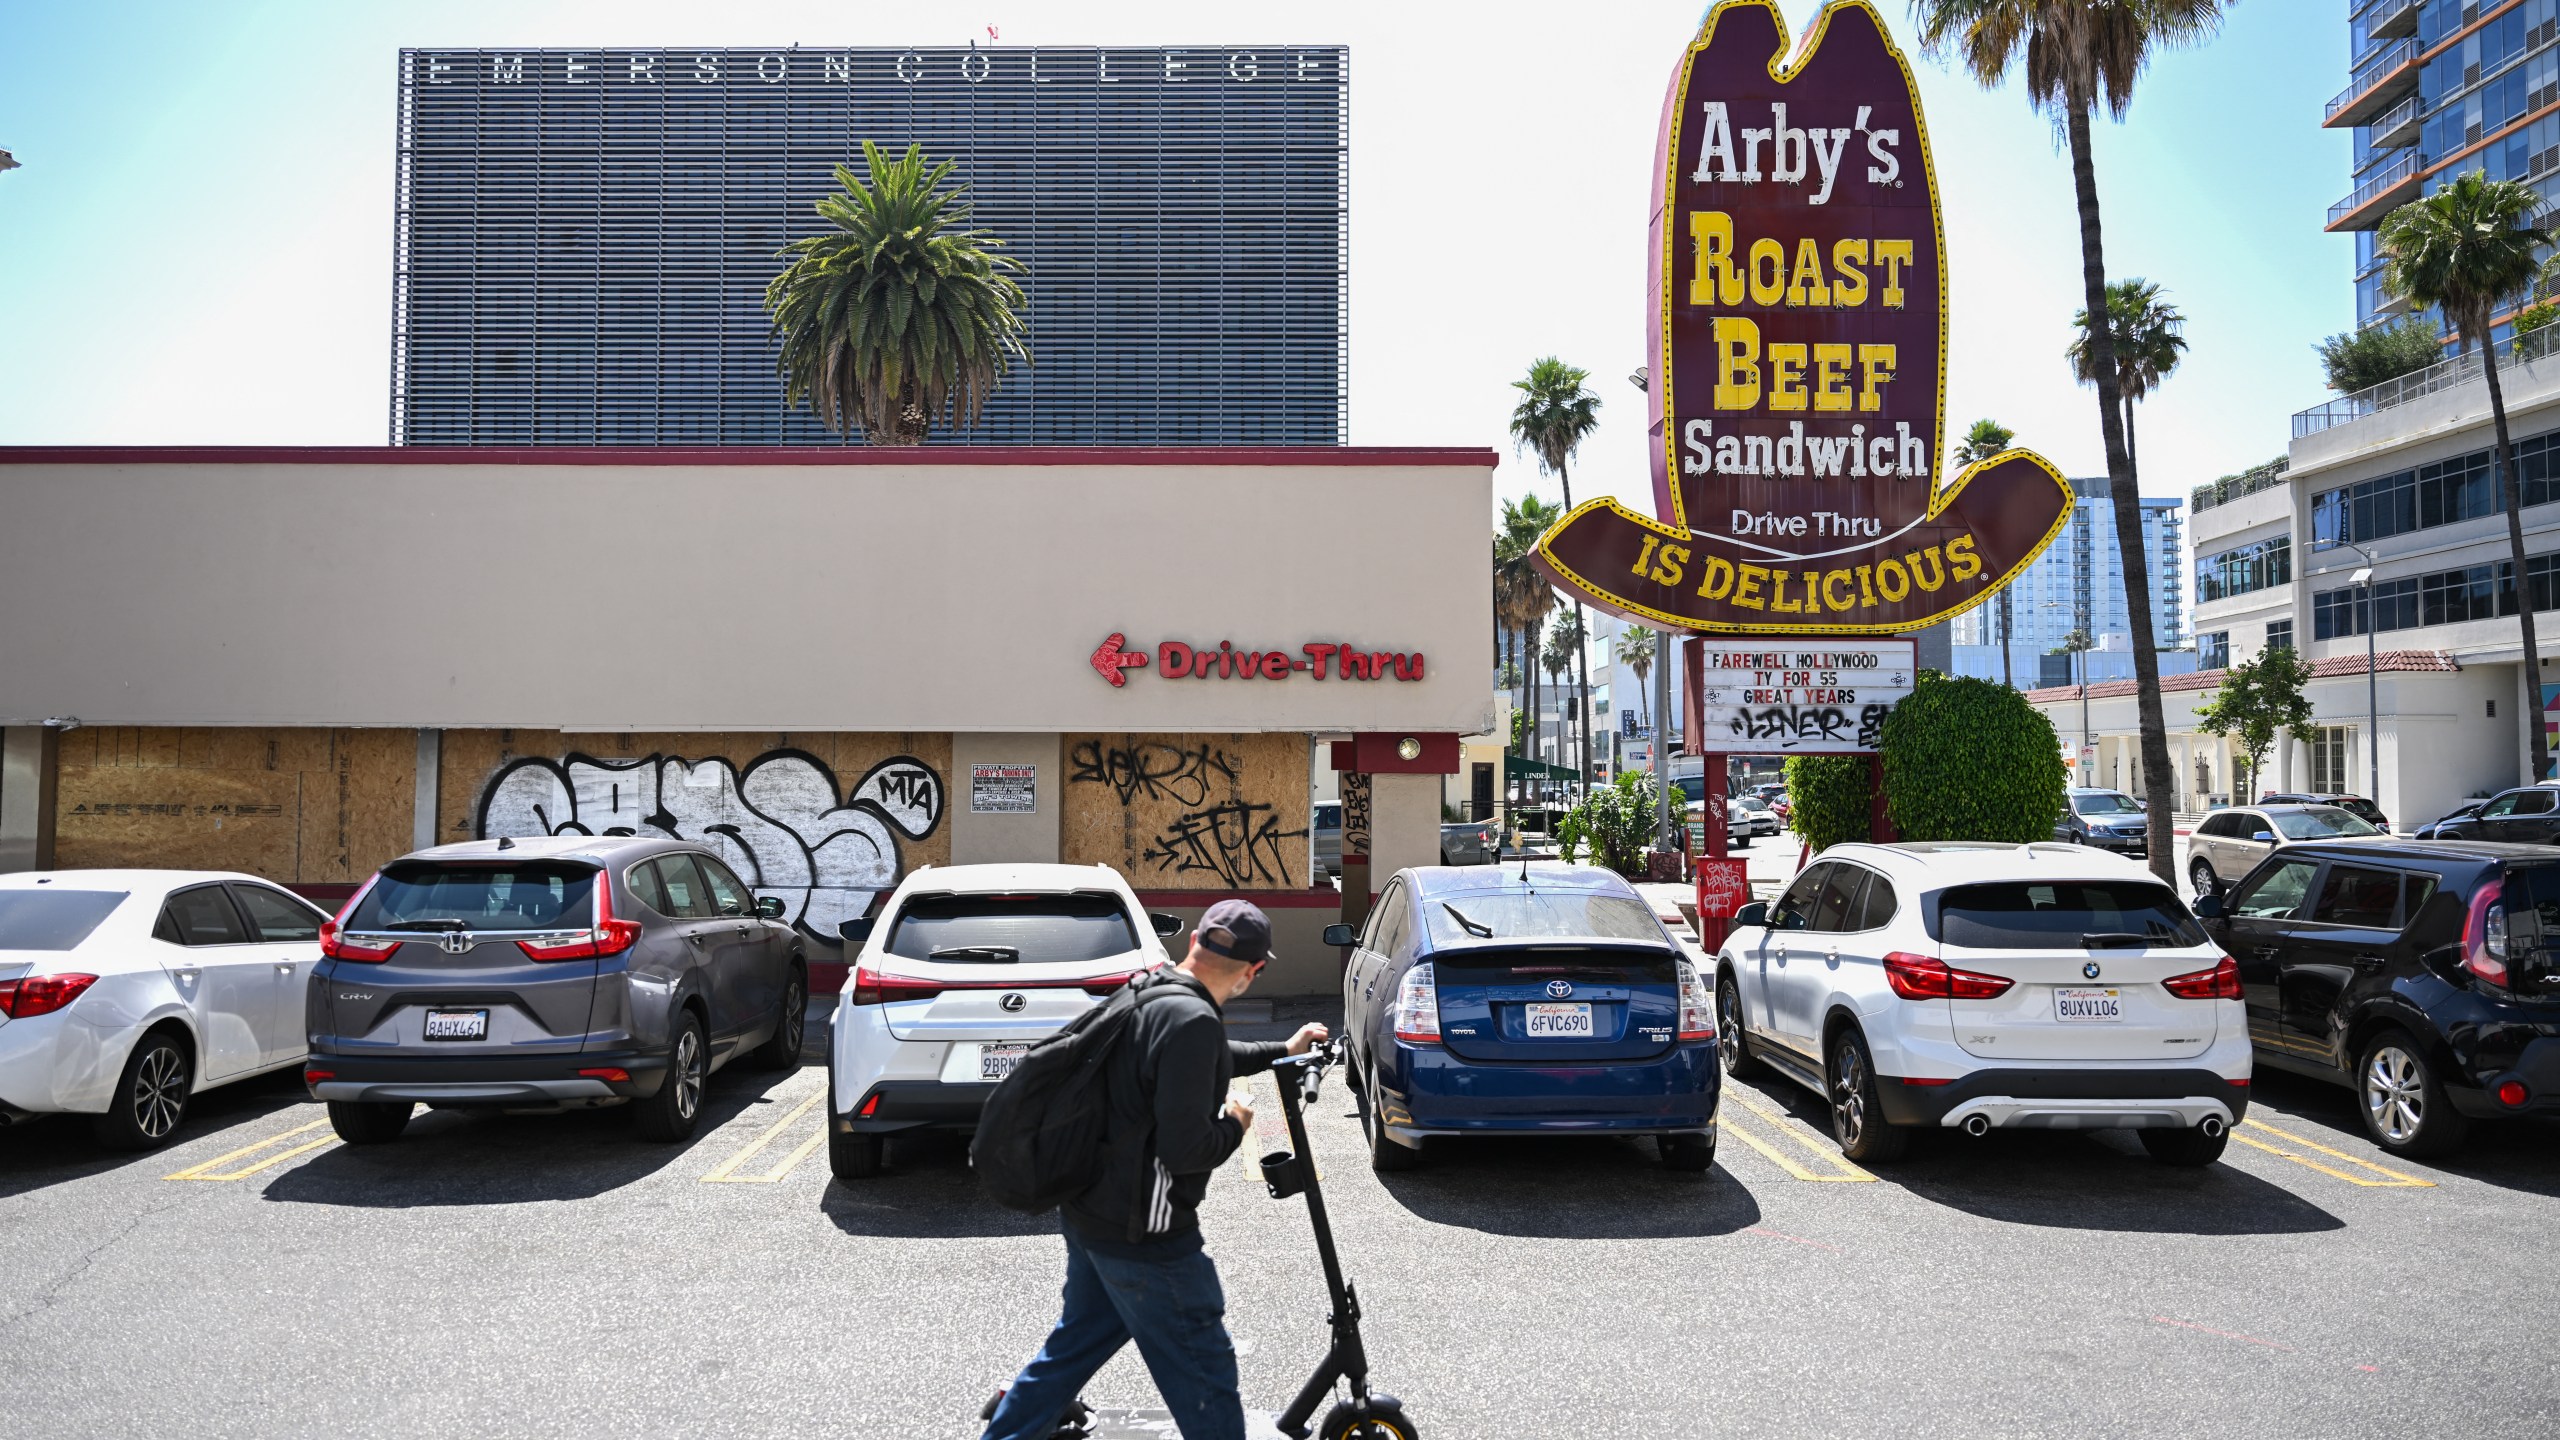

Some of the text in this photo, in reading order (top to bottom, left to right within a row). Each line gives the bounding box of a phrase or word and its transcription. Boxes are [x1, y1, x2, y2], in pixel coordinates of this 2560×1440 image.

[1692, 101, 1900, 205] Arby's
[1689, 211, 1914, 307] ROAST
[1713, 316, 1897, 412] BEEF
[1684, 419, 1929, 477] Sandwich
[1732, 509, 1882, 537] Drive Thru
[1631, 532, 1983, 615] IS DELICIOUS
[1158, 640, 1425, 682] Drive-Thru
[1713, 653, 1879, 669] FAREWELL HOLLYWOOD
[1755, 671, 1838, 686] TY FOR 55
[1743, 689, 1855, 704] GREAT YEARS
[975, 769, 1000, 777] ARBY'S
[879, 771, 932, 820] MTA
[340, 992, 375, 1000] CR-V
[2068, 990, 2105, 999] California
[1539, 1005, 1576, 1015] California
[2060, 1000, 2119, 1016] 8UXV106
[429, 1020, 482, 1037] 8AHX461
[1531, 1015, 1589, 1031] 6FVC690
